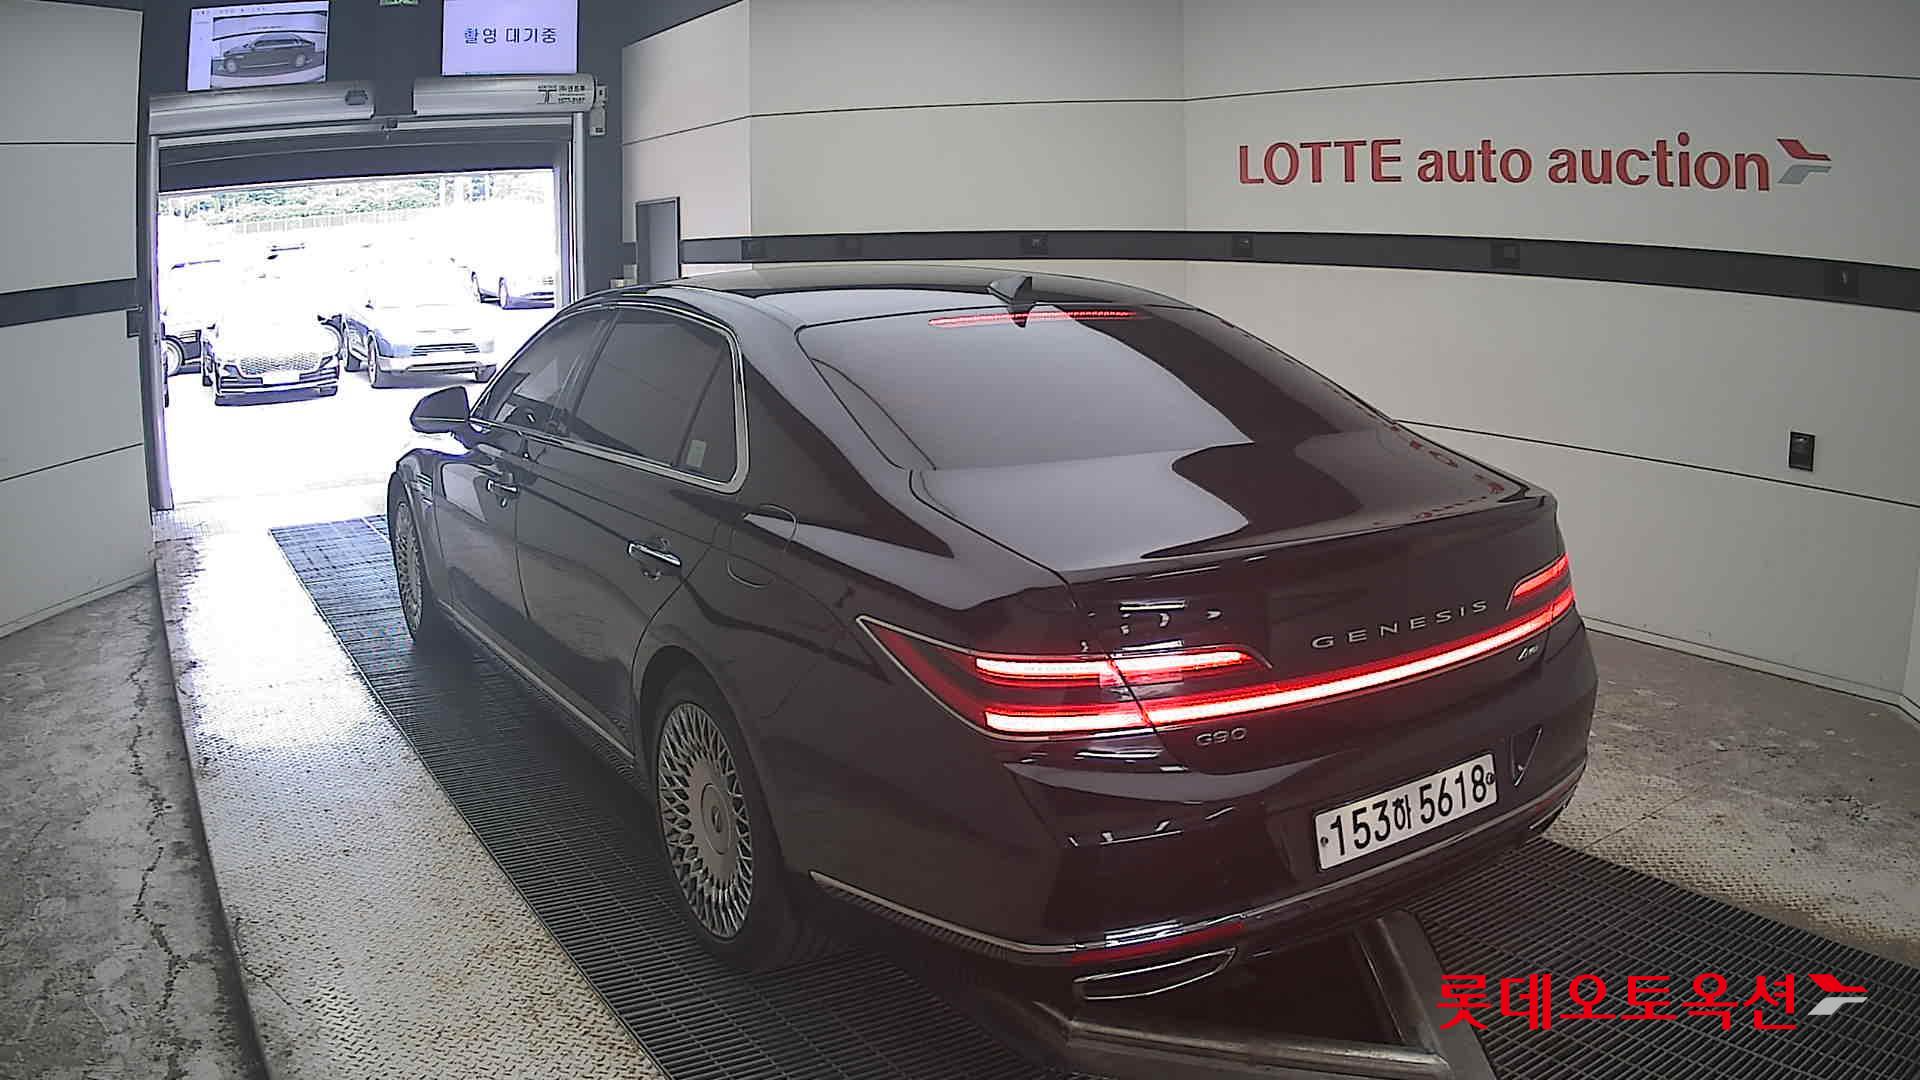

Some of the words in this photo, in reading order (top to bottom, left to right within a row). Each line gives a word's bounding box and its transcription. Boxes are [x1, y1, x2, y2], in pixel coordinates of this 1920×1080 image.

[505, 27, 557, 44] 대기중
[1238, 138, 1402, 185] LOTTE
[1416, 140, 1533, 184] auto
[1547, 131, 1771, 191] auction
[1310, 600, 1488, 649] GENESIS
[1195, 726, 1248, 746] G90
